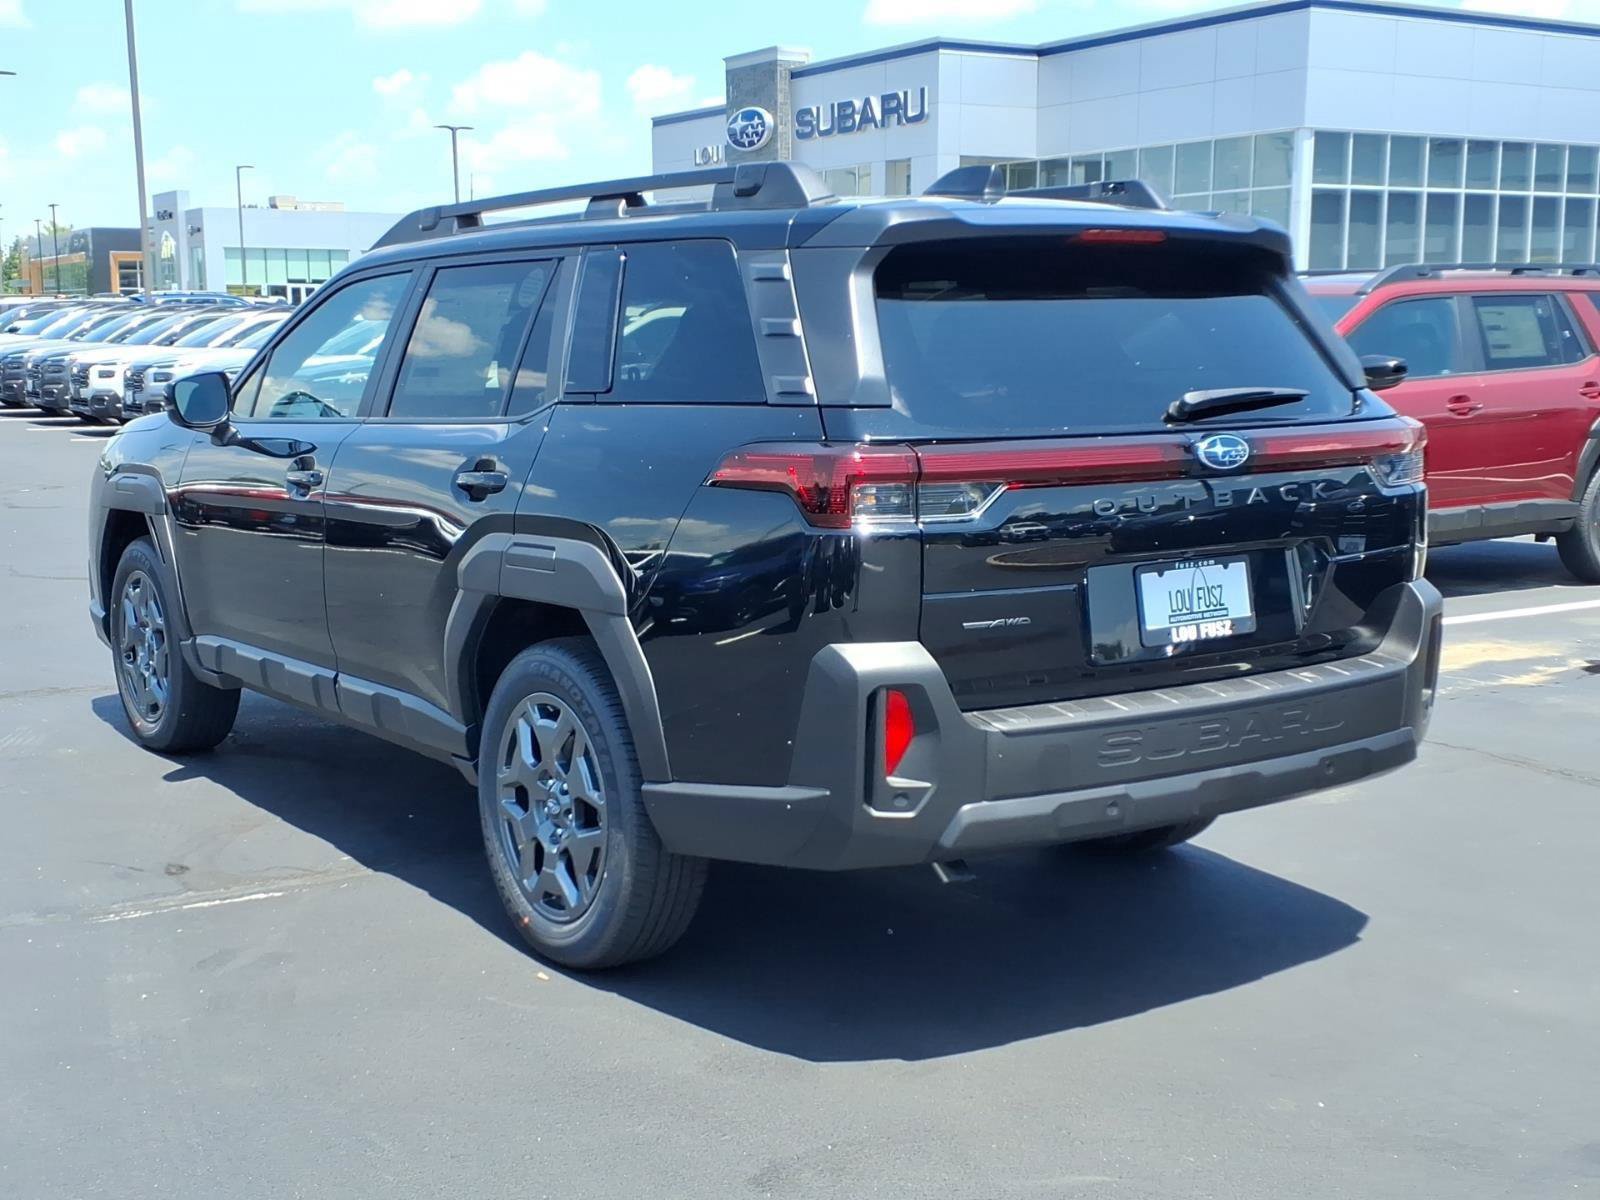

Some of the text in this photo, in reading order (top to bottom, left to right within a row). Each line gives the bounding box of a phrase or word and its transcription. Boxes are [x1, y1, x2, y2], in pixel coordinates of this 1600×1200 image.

[795, 86, 928, 140] SUBARU
[694, 145, 722, 166] LOU
[1092, 482, 1328, 516] OUTBACK
[1175, 559, 1216, 569] fusz.com
[1168, 584, 1226, 613] LOU FUSZ
[990, 616, 1032, 629] AWD
[1170, 619, 1233, 643] LOU FUSZ
[1097, 701, 1346, 768] SUBARU
